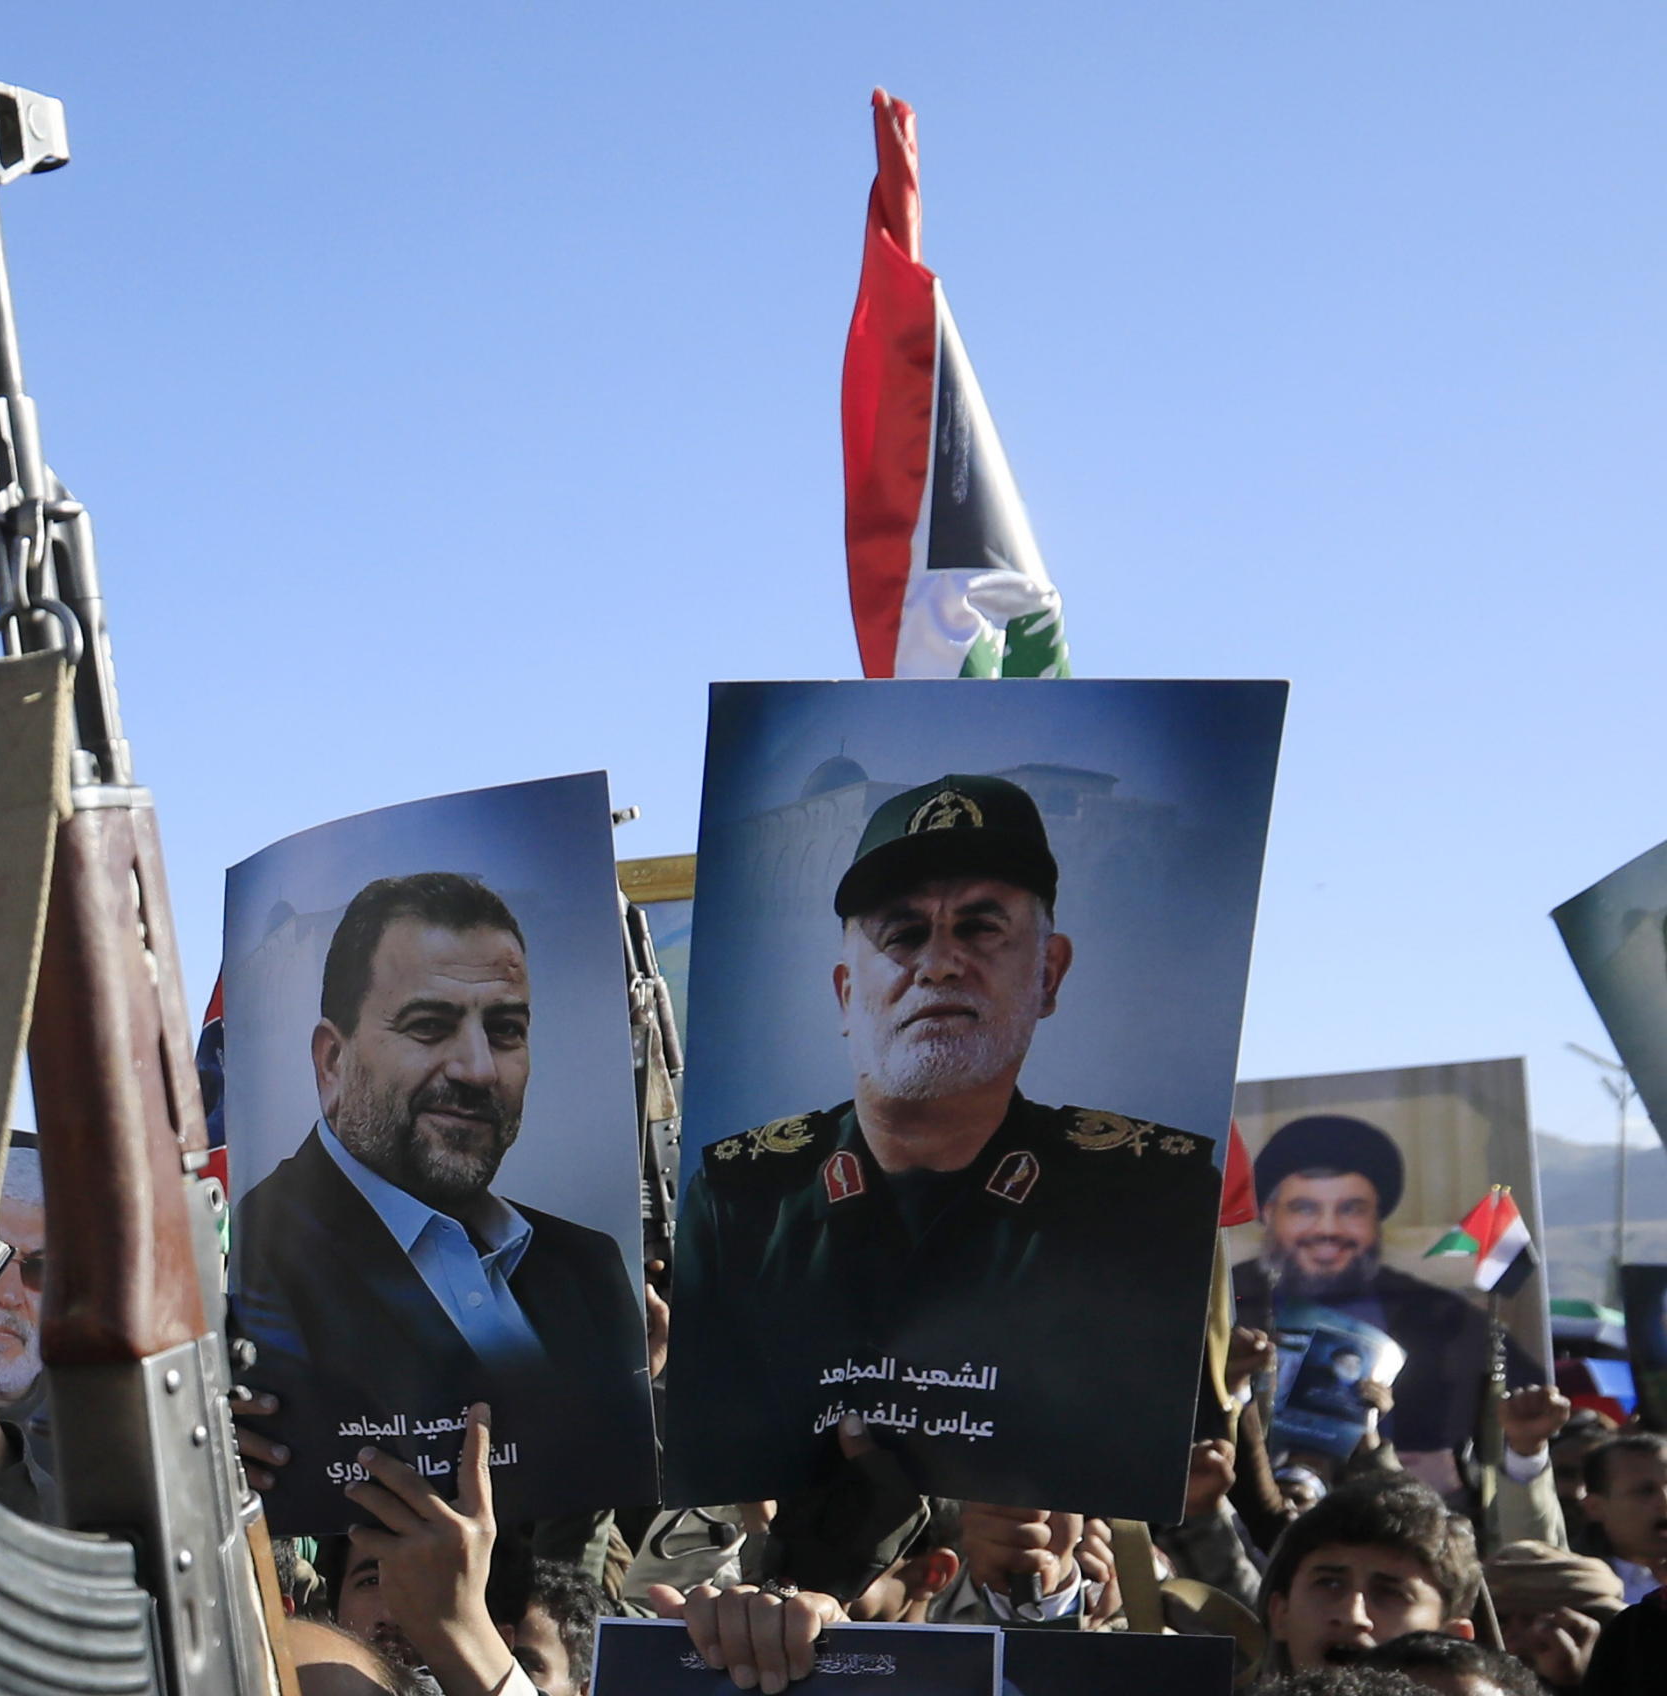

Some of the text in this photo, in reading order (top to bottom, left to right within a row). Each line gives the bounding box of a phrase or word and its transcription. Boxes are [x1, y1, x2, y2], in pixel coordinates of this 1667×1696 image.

[819, 1358, 999, 1392] الشهيد المجاهد
[338, 1405, 469, 1441] شهيد المجاهد
[924, 1410, 994, 1442] عباس
[326, 1460, 371, 1485] روري
[412, 1454, 452, 1478] صال
